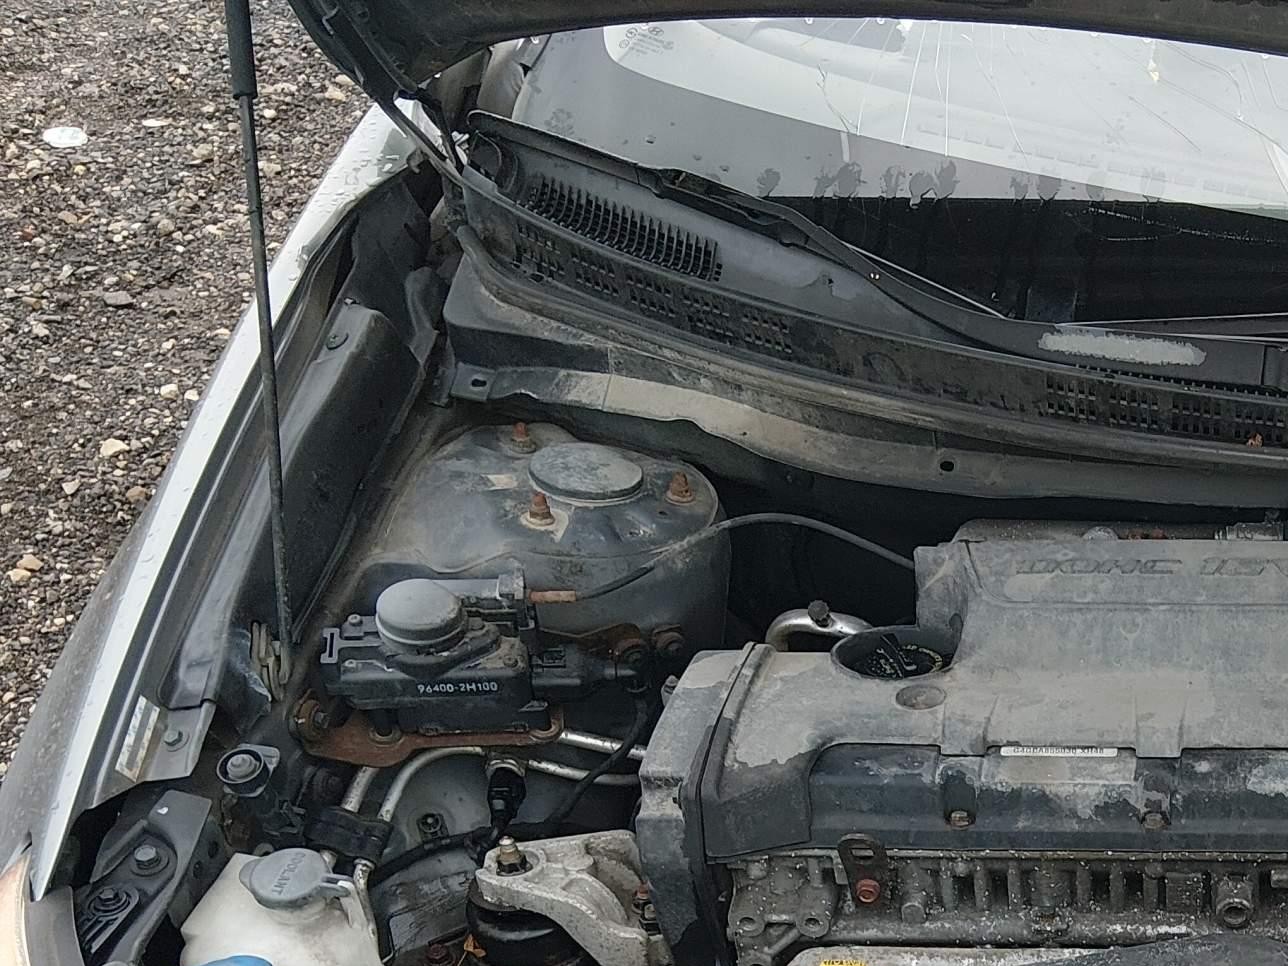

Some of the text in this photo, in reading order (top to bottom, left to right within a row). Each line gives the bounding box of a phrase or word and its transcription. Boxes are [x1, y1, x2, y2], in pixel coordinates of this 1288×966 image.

[1016, 559, 1182, 575] DOHC
[417, 681, 498, 694] 96400-2H100
[271, 852, 306, 896] COOLANT
